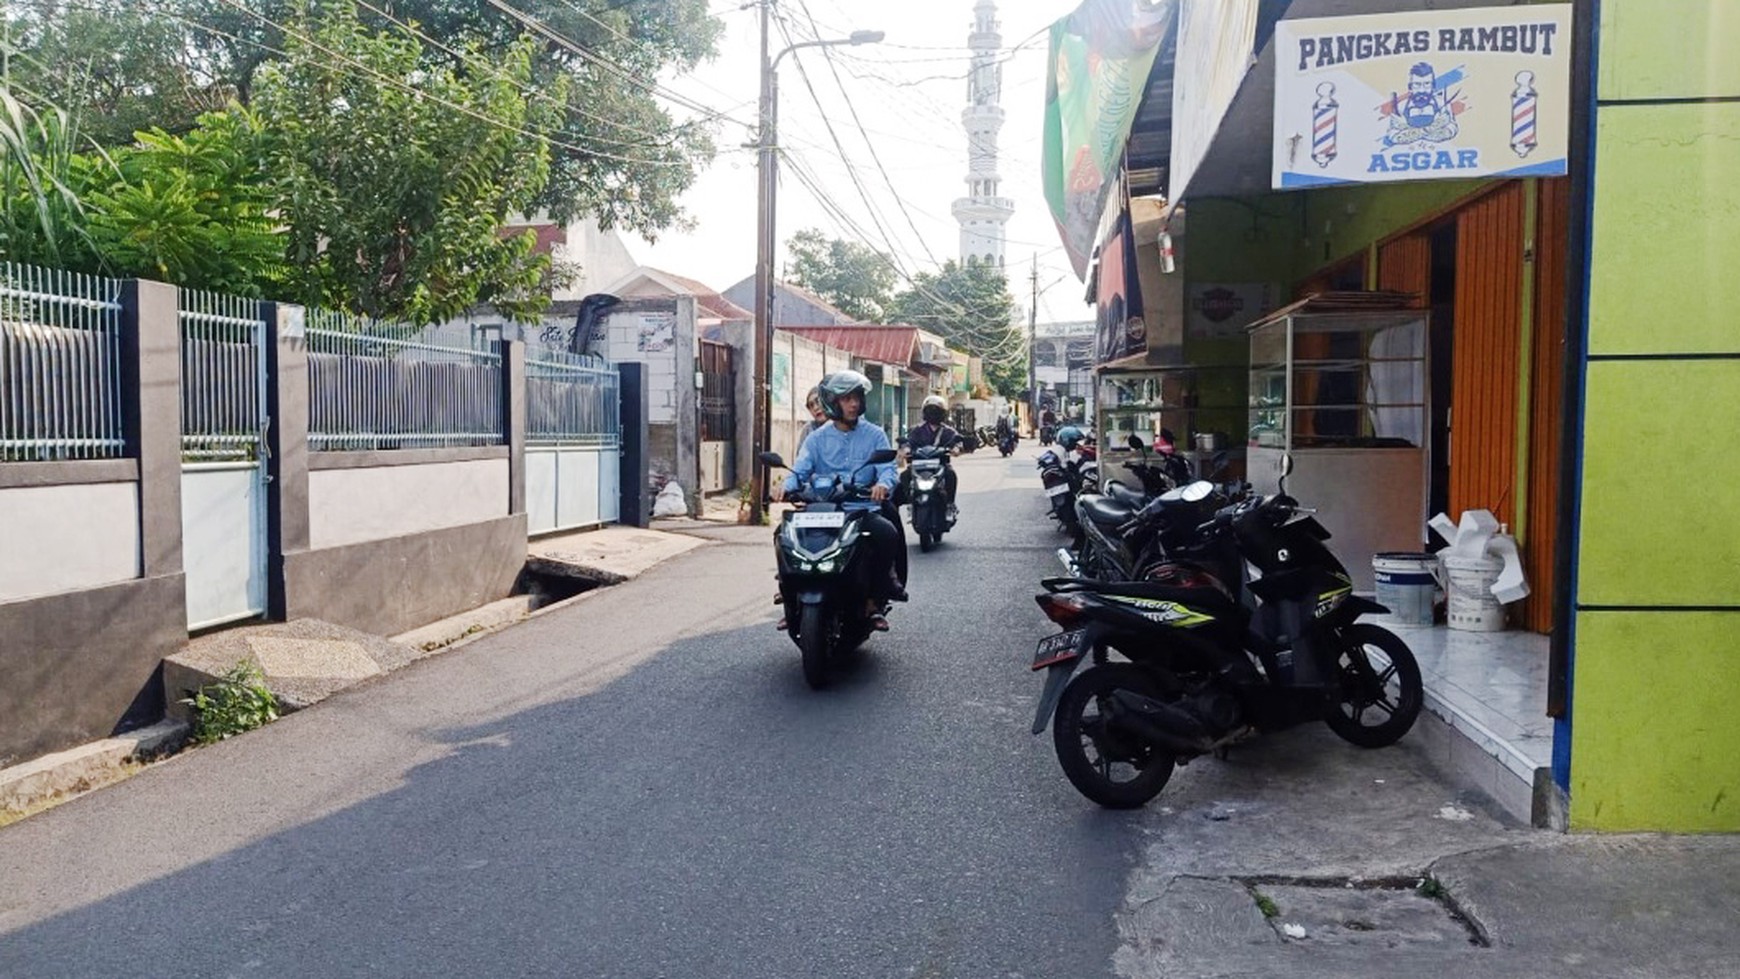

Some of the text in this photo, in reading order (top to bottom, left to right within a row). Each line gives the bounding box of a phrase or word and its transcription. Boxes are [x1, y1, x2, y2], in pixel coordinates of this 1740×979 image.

[1299, 24, 1556, 71] PANGKAS RAMBUT
[1368, 150, 1478, 173] ASGAR
